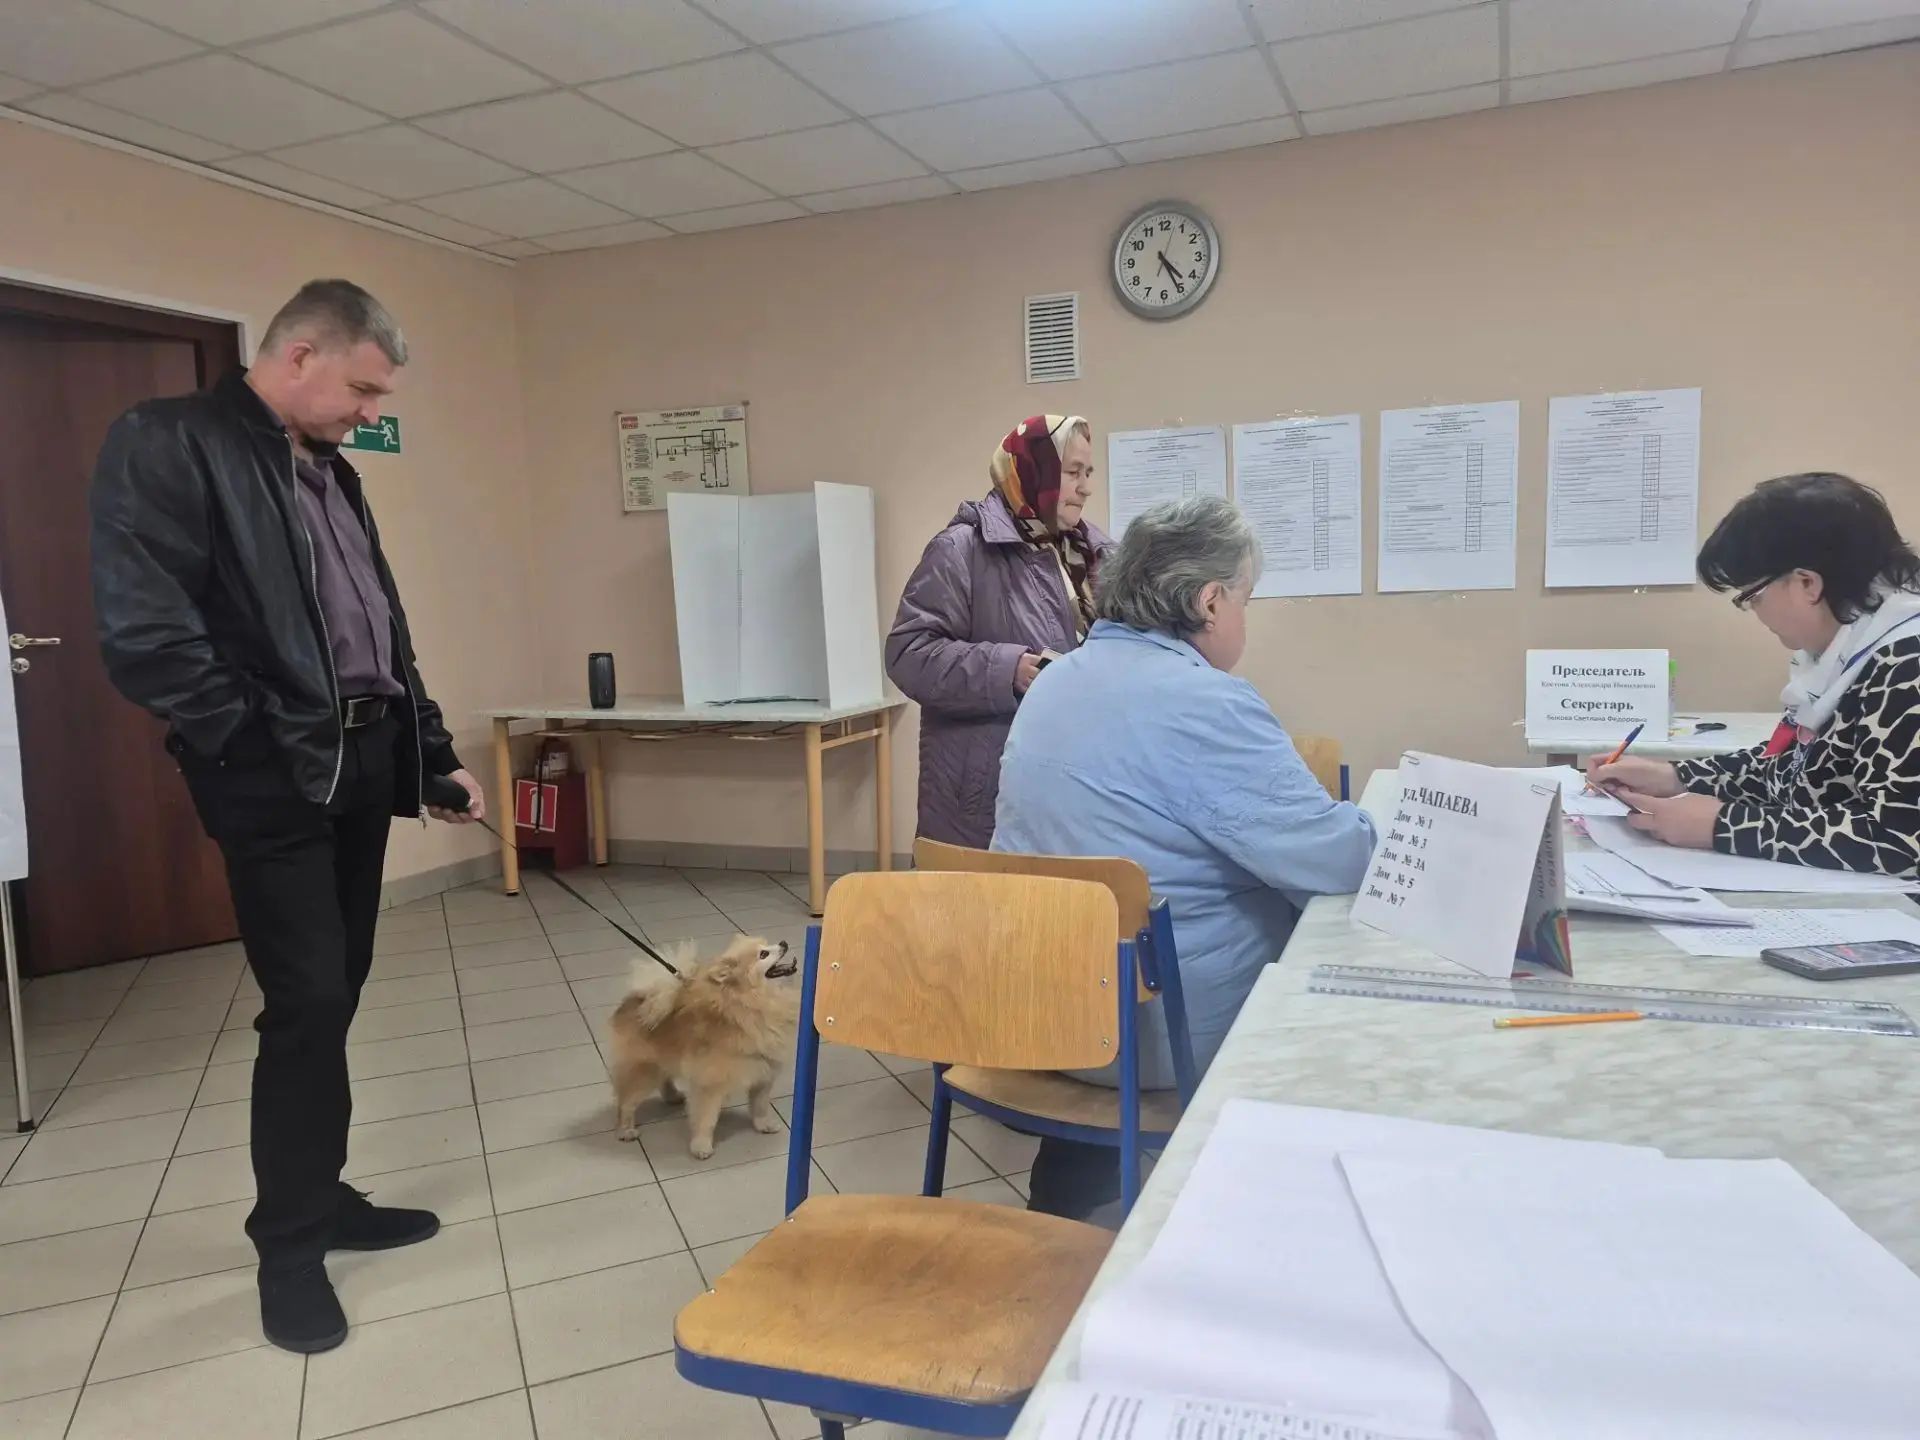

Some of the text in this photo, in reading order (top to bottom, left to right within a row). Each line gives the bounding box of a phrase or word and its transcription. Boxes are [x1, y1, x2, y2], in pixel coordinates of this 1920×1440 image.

[1158, 220, 1172, 232] 12
[1179, 223, 1185, 234] 1
[1143, 227, 1154, 238] 11
[1189, 233, 1198, 244] 2
[1130, 240, 1145, 251] 10
[1194, 251, 1203, 262] 3
[1127, 258, 1136, 269] 9
[1188, 269, 1197, 280] 4
[1132, 275, 1141, 286] 8
[1144, 287, 1152, 297] 7
[1177, 283, 1185, 294] 5
[1160, 289, 1169, 300] 6
[1552, 665, 1646, 678] Председатель
[1560, 698, 1634, 712] Секретарь
[1573, 714, 1606, 723] Светлана
[1400, 787, 1478, 817] ул.ЧАПАЕВА
[1394, 810, 1433, 829] Дом № 1
[1387, 828, 1428, 849] Дом № 3
[1380, 847, 1425, 871] Дом № 3А
[1373, 866, 1415, 888] Дом № 5
[1366, 884, 1406, 907] Дом № 7
